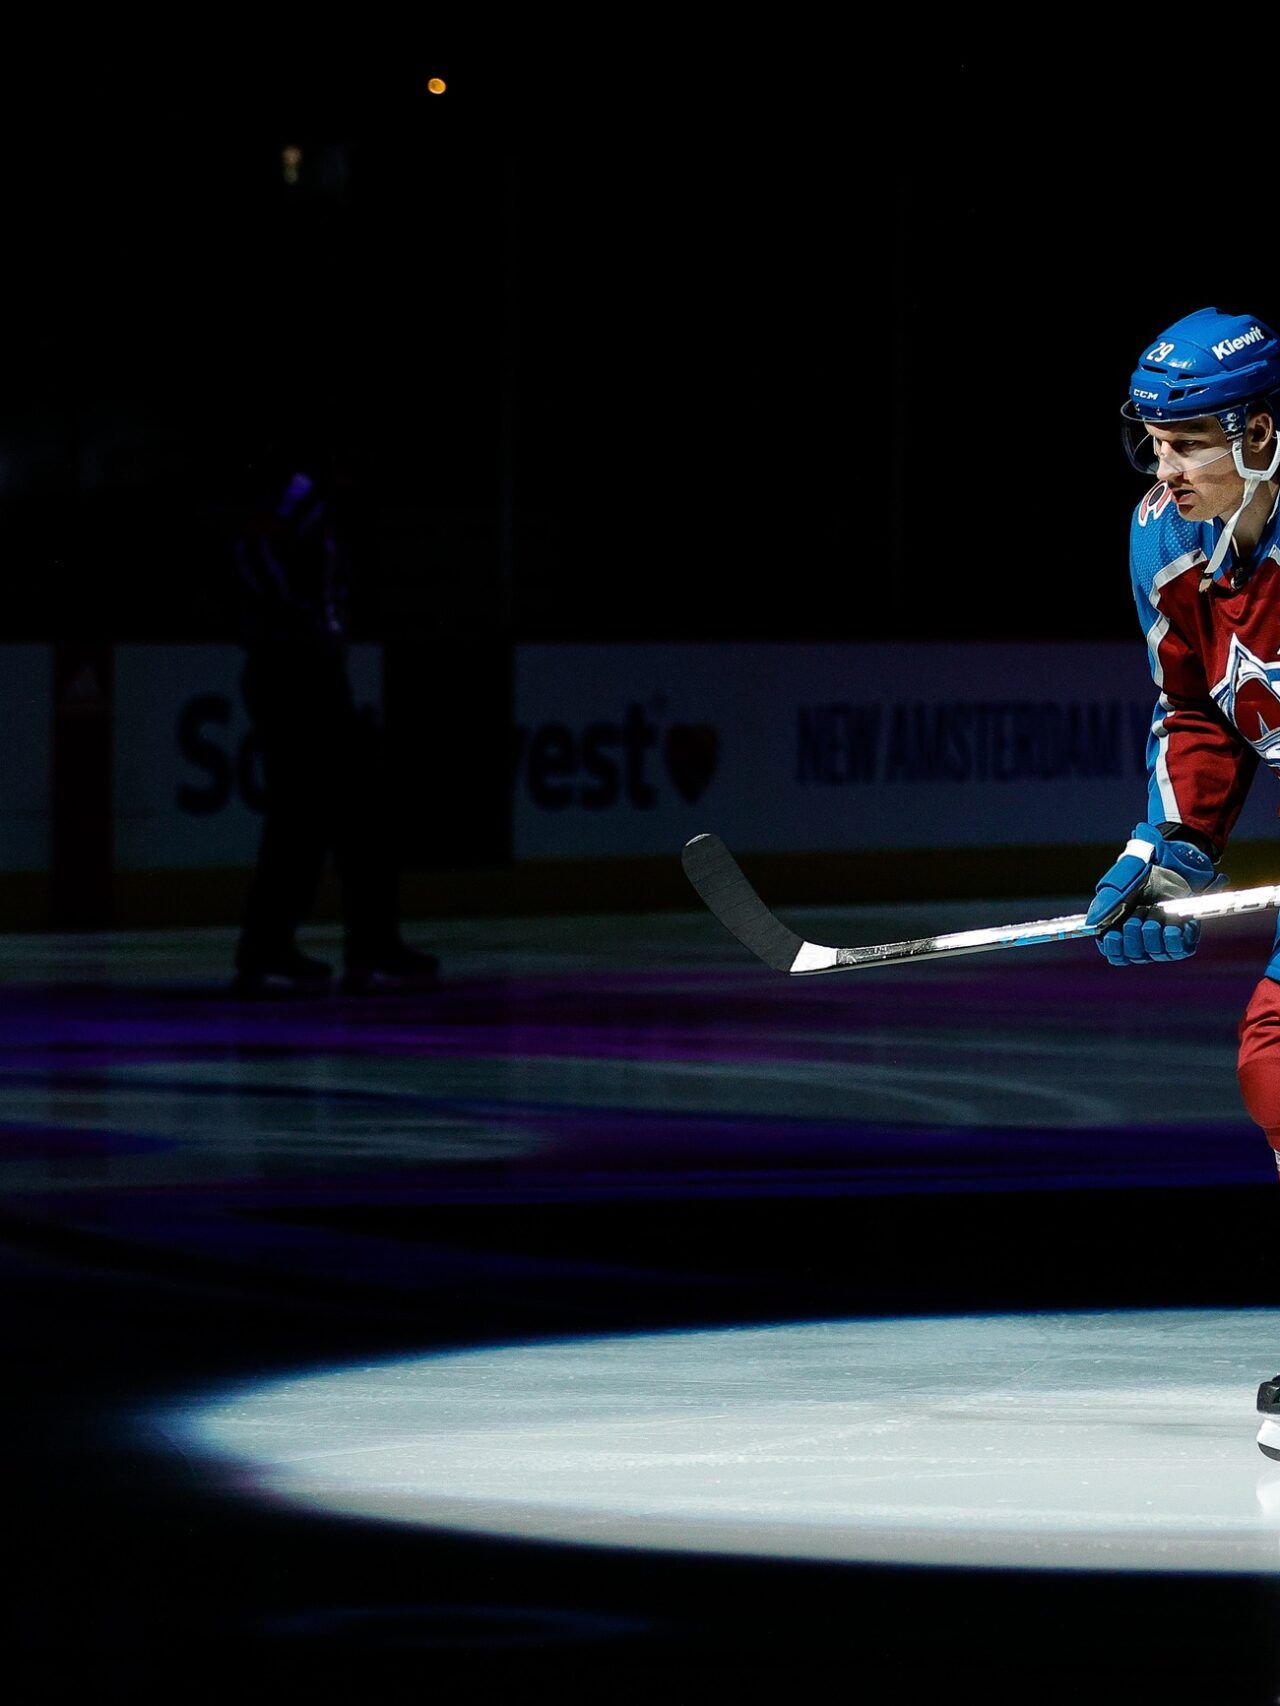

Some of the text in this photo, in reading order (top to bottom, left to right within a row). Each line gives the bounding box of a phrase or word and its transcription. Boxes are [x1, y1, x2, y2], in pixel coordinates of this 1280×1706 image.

[1146, 341, 1175, 363] 29
[1211, 326, 1264, 361] Kiewit
[1133, 388, 1158, 400] CCM
[883, 701, 1122, 783] AMSTERDAM
